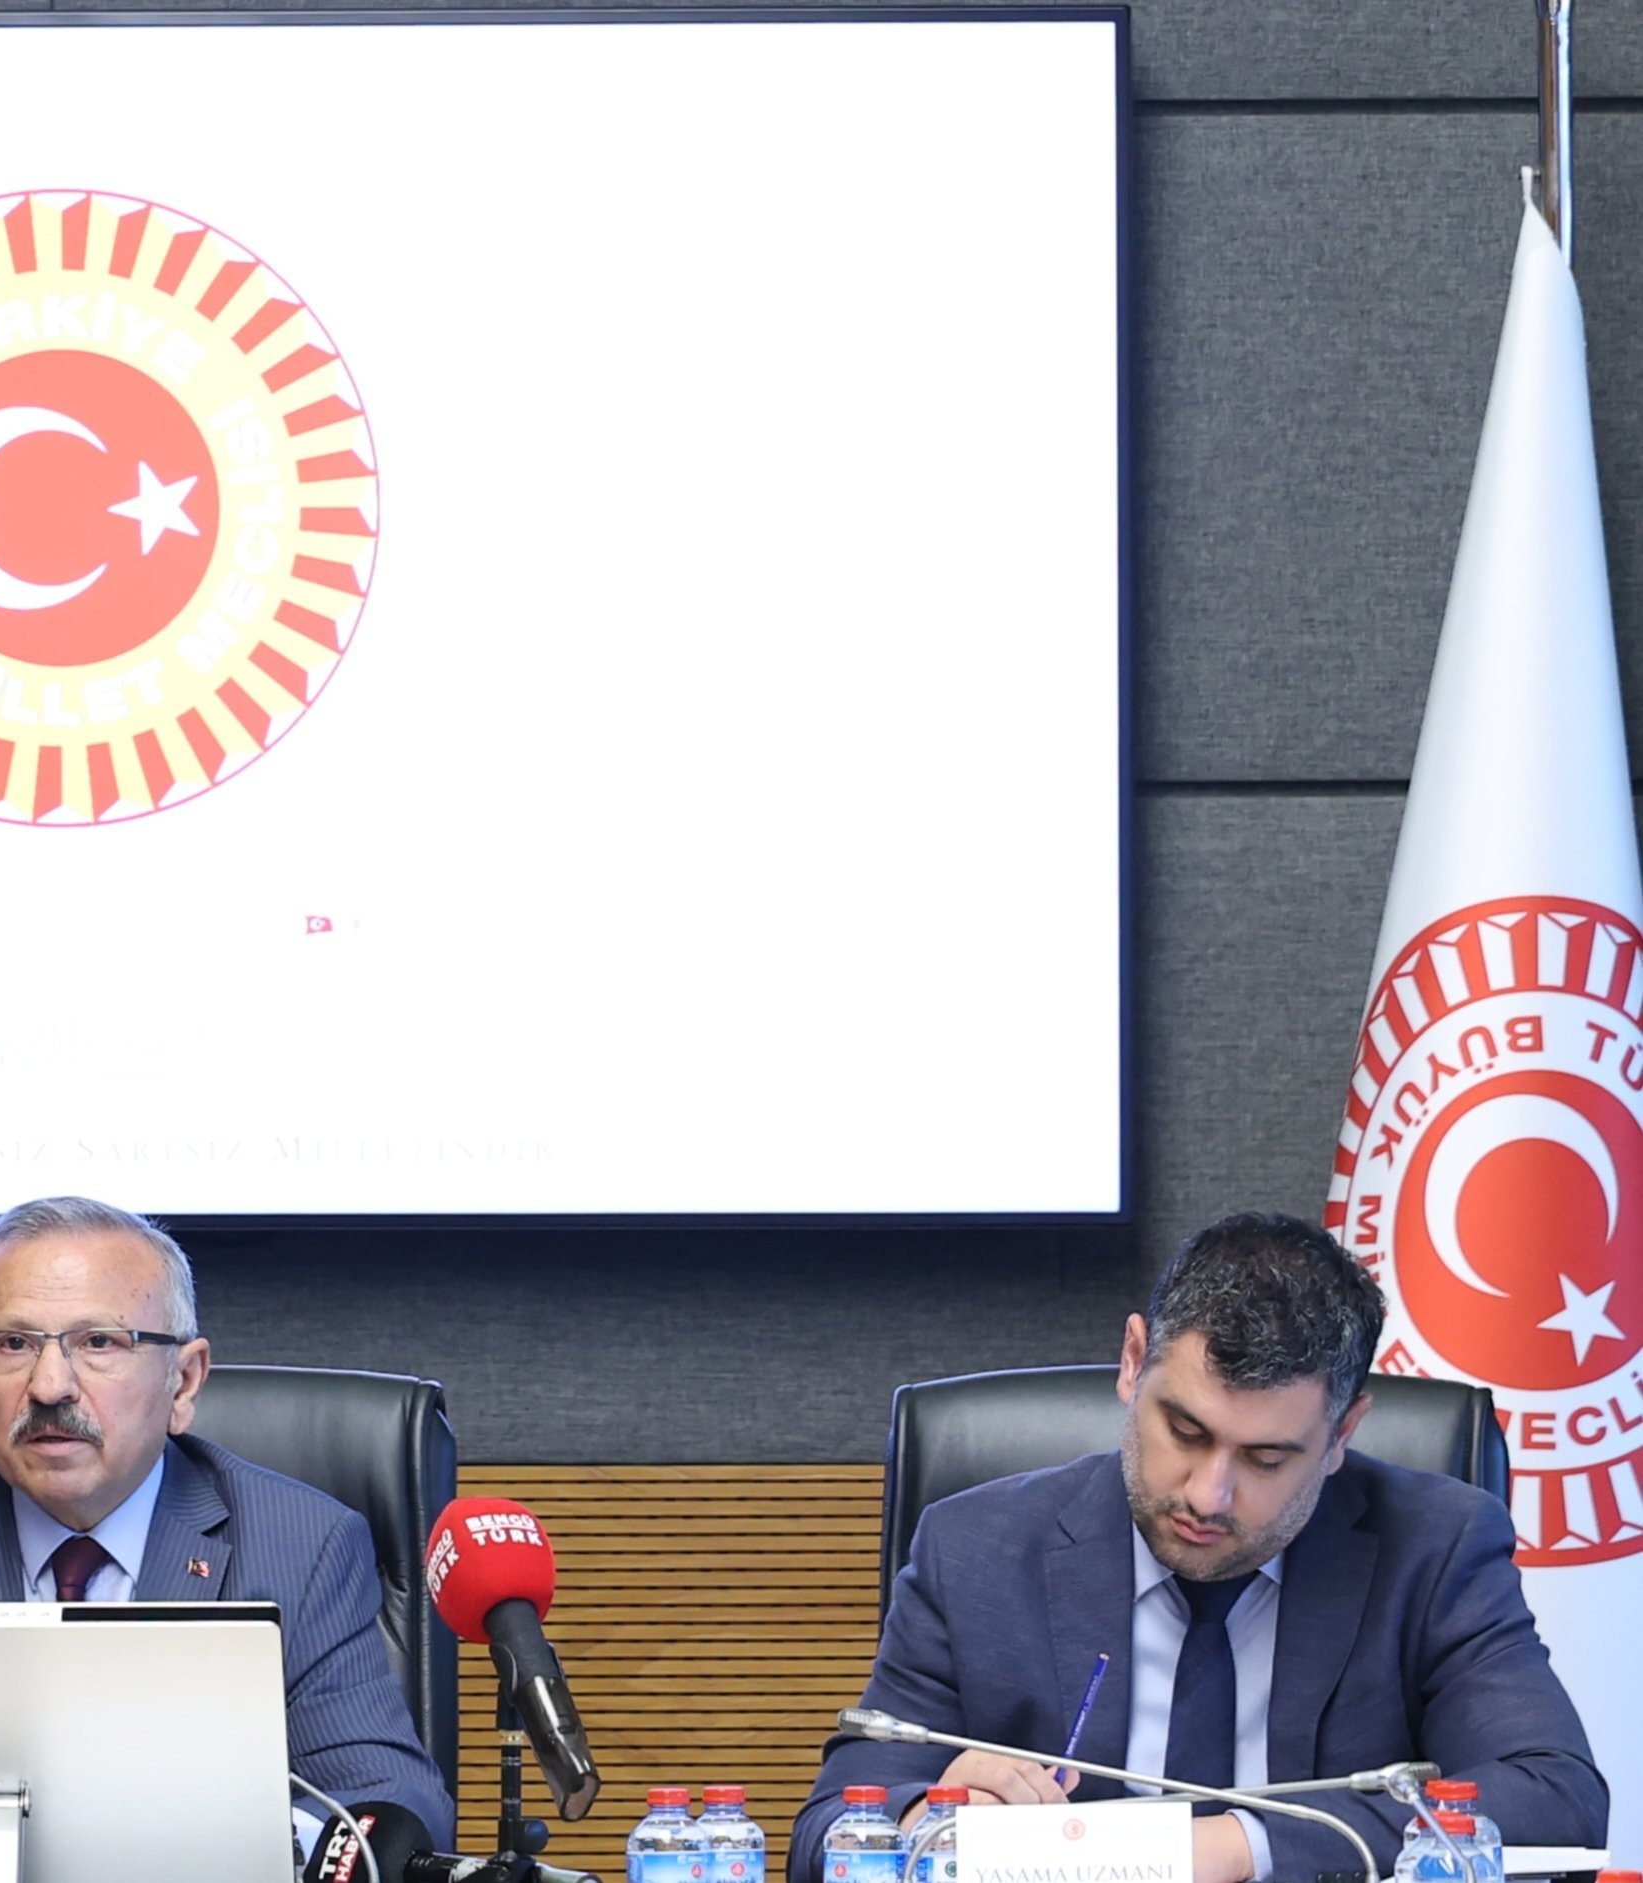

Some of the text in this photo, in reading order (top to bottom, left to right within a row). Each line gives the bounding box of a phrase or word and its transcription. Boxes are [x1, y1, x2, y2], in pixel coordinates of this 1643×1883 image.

[1368, 1015, 1544, 1170] BÜYÜK
[334, 1816, 375, 1883] HABR
[1075, 1864, 1173, 1882] UZMANI
